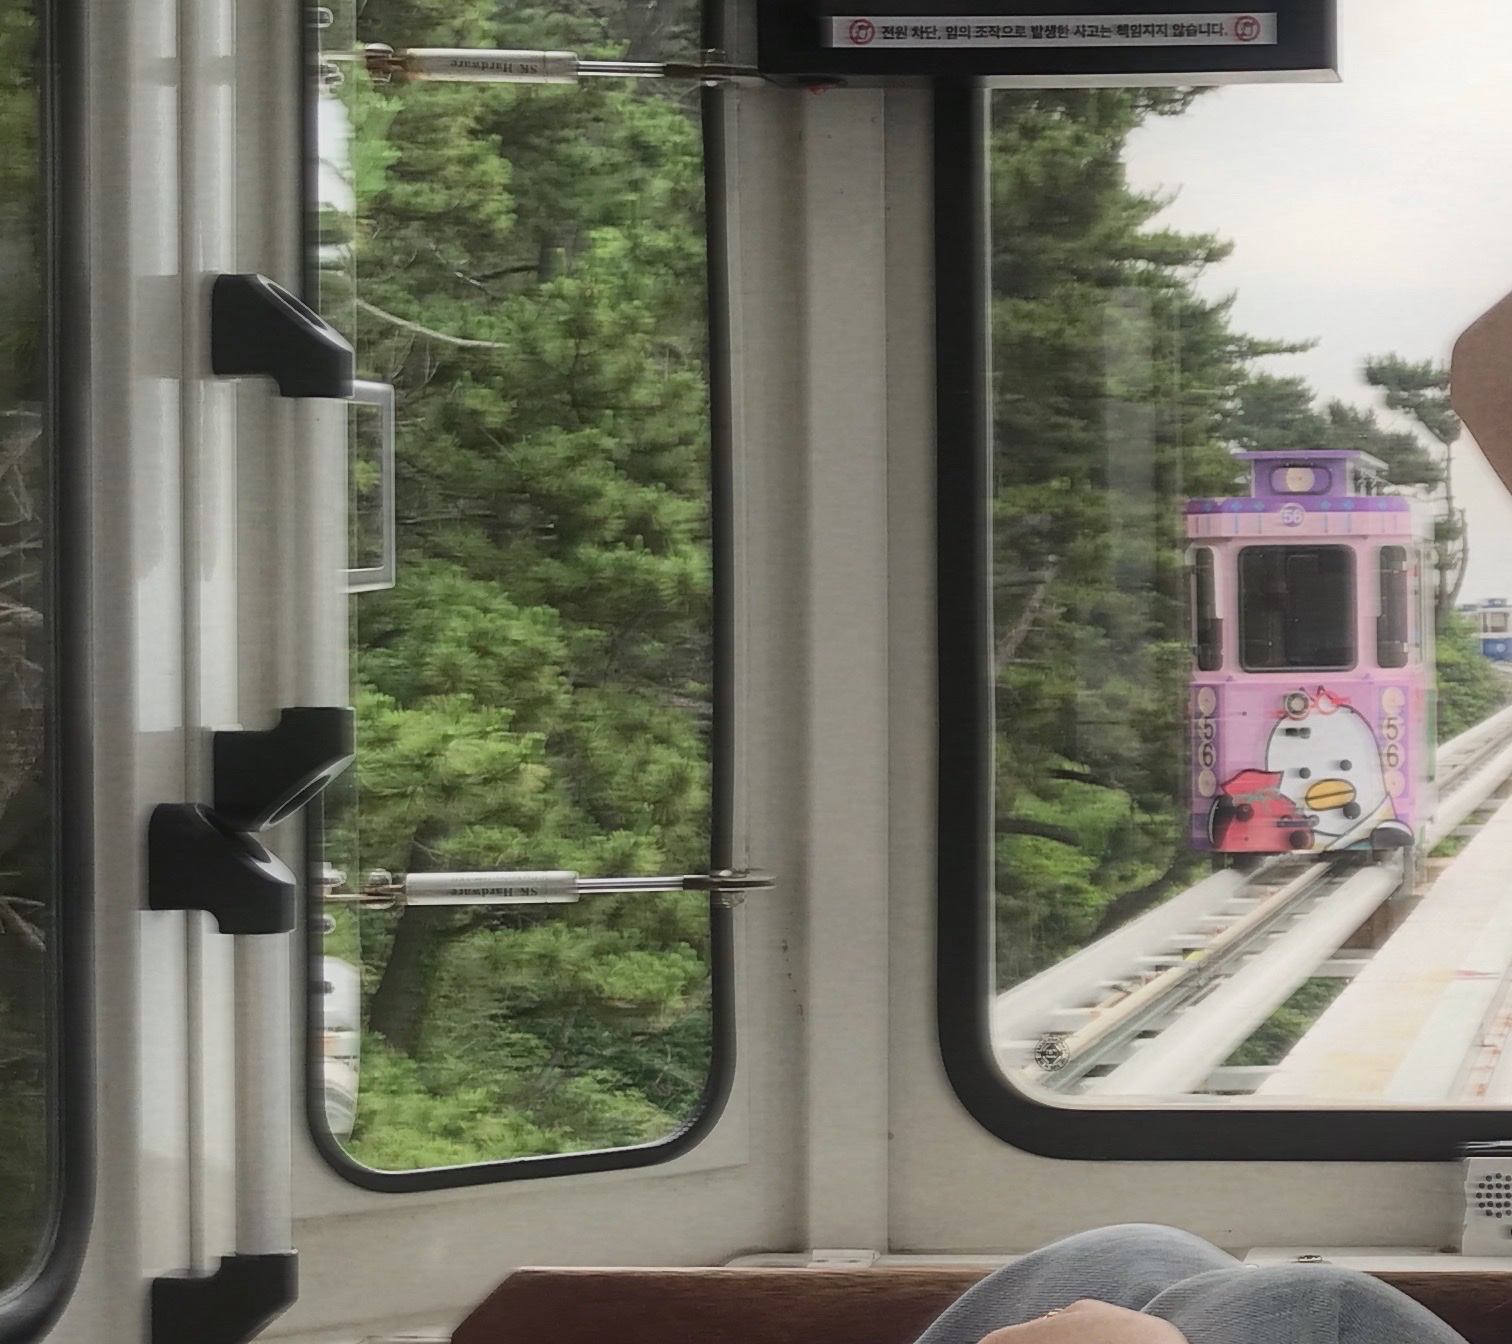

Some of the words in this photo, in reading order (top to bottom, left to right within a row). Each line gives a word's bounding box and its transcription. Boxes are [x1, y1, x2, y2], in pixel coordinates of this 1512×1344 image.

[881, 25, 907, 40] 전원
[911, 25, 941, 40] 차단,
[945, 24, 971, 39] 임의
[975, 24, 1027, 39] 조작으로
[1031, 24, 1070, 38] 발생한
[1074, 24, 1113, 38] 사고는
[1172, 22, 1228, 37] 않습니다.
[450, 59, 513, 73] Hardware
[519, 63, 538, 74] SK
[450, 887, 513, 897] Hardware
[519, 887, 538, 897] SK
